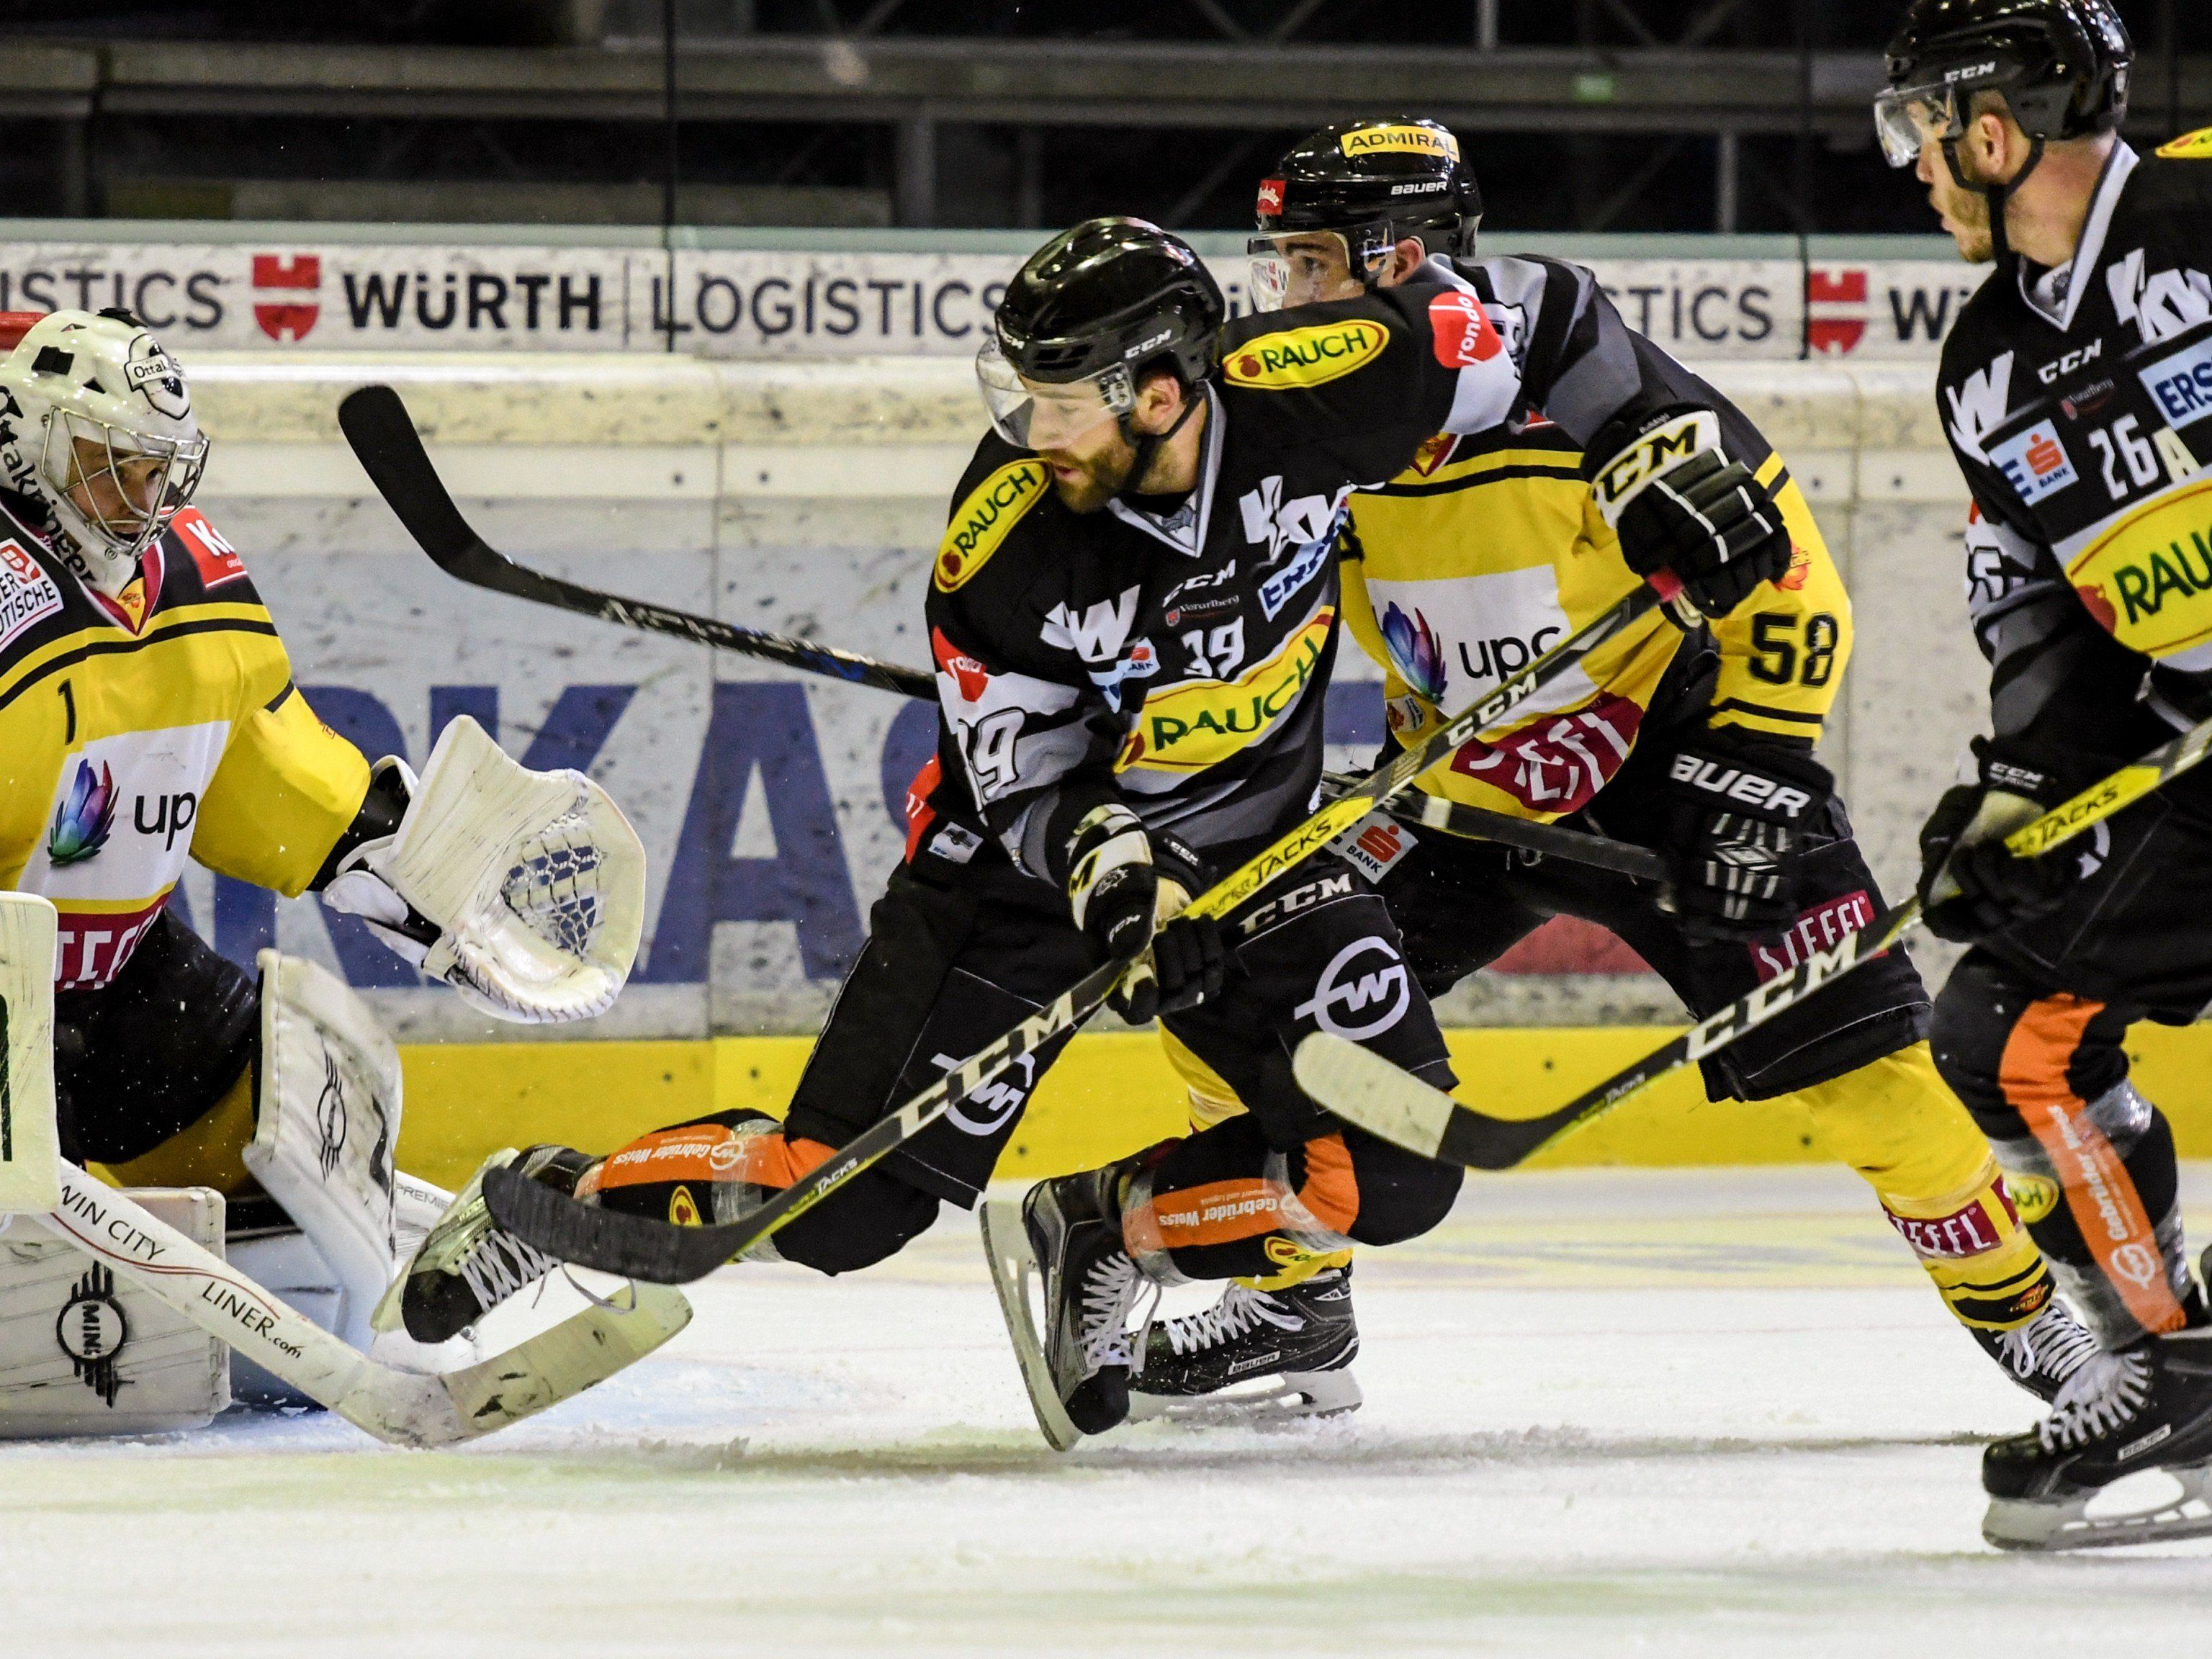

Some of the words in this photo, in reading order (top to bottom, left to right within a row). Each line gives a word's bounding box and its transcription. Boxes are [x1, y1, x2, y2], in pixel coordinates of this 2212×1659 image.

[1944, 62, 1996, 83] CCM
[1349, 131, 1457, 156] ADMIRAL
[652, 275, 1007, 337] LOGISTICS
[1429, 296, 1486, 364] rondo
[1606, 286, 1772, 342] TICS
[1125, 328, 1172, 359] CCM
[1261, 328, 1367, 373] RAUCH
[2037, 338, 2102, 385] CCM
[1593, 423, 1697, 502] CM
[2038, 467, 2070, 488] BANK
[2089, 413, 2159, 500] 26
[953, 466, 1038, 559] RAUCH
[0, 572, 20, 603] ER
[2113, 524, 2212, 624] RAU
[0, 580, 55, 637] TISCHE
[1179, 594, 1240, 613] Vorarlberg
[1748, 611, 1838, 689] 58
[58, 678, 76, 745] 1
[1152, 637, 1320, 751] RAUCH
[1446, 671, 1538, 747] CCM
[1346, 845, 1382, 873] BANK
[1239, 873, 1352, 934] CCM
[1686, 931, 1859, 1061] CCM
[890, 991, 1074, 1139] CCM
[1159, 1210, 1200, 1226] Weiss
[1202, 1197, 1277, 1222] Gebrüder
[108, 1220, 166, 1261] CITY
